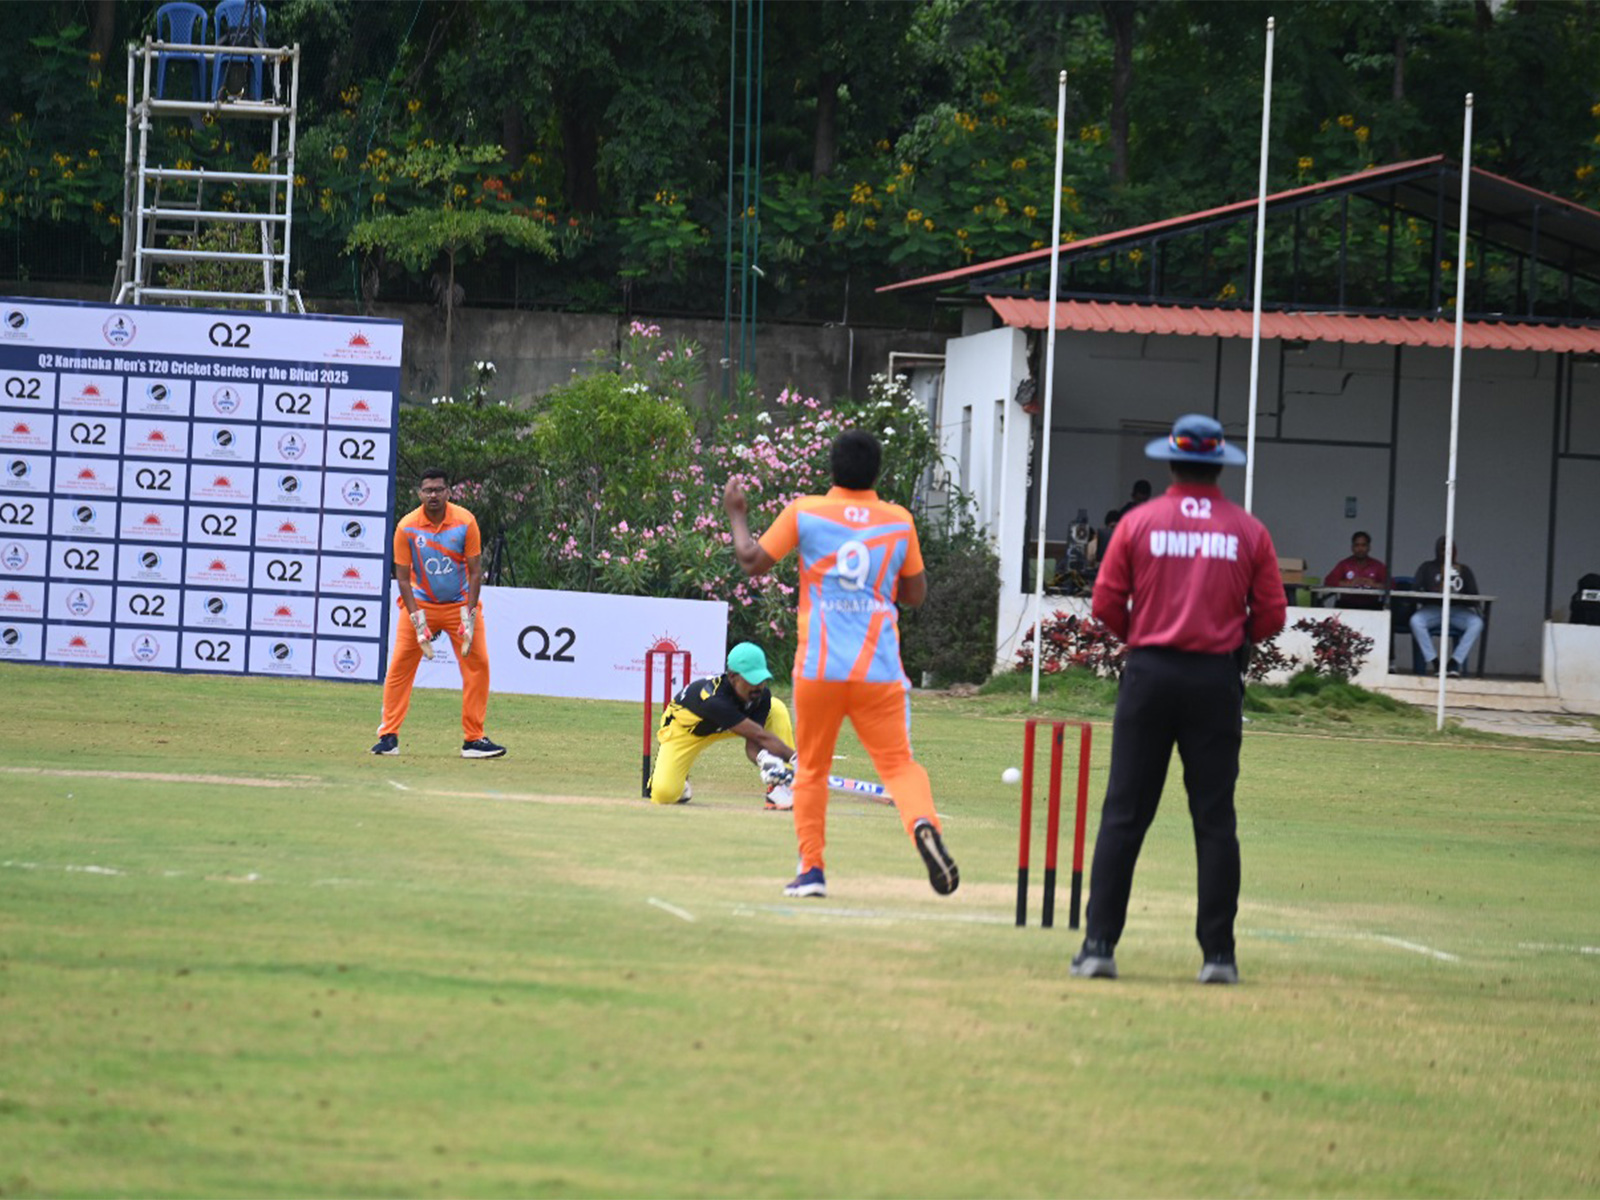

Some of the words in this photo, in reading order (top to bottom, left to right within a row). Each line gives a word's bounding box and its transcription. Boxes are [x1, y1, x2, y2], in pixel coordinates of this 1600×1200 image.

[208, 322, 251, 348] Q2
[38, 353, 54, 369] Q2
[55, 354, 112, 371] Karnataka
[113, 357, 146, 373] Men's
[148, 359, 168, 374] T20
[170, 360, 211, 376] Cricket
[213, 363, 250, 378] Series
[251, 364, 268, 379] for
[269, 366, 287, 381] the
[289, 367, 319, 383] Blind
[320, 369, 350, 384] 2025
[5, 377, 41, 400] Q2
[275, 392, 312, 415] Q2
[71, 422, 106, 445] Q2
[339, 438, 376, 461] Q2
[135, 468, 172, 491] Q2
[0, 502, 34, 526] Q2
[844, 506, 870, 523] Q2
[1180, 496, 1212, 520] Q2
[200, 514, 237, 537] Q2
[1149, 530, 1239, 562] UMPIRE
[63, 548, 100, 571] Q2
[267, 559, 303, 582] Q2
[424, 556, 454, 575] Q2
[836, 540, 871, 591] 9
[129, 594, 165, 616] Q2
[331, 605, 367, 628] Q2
[194, 639, 231, 662] Q2
[517, 625, 576, 663] Q2
